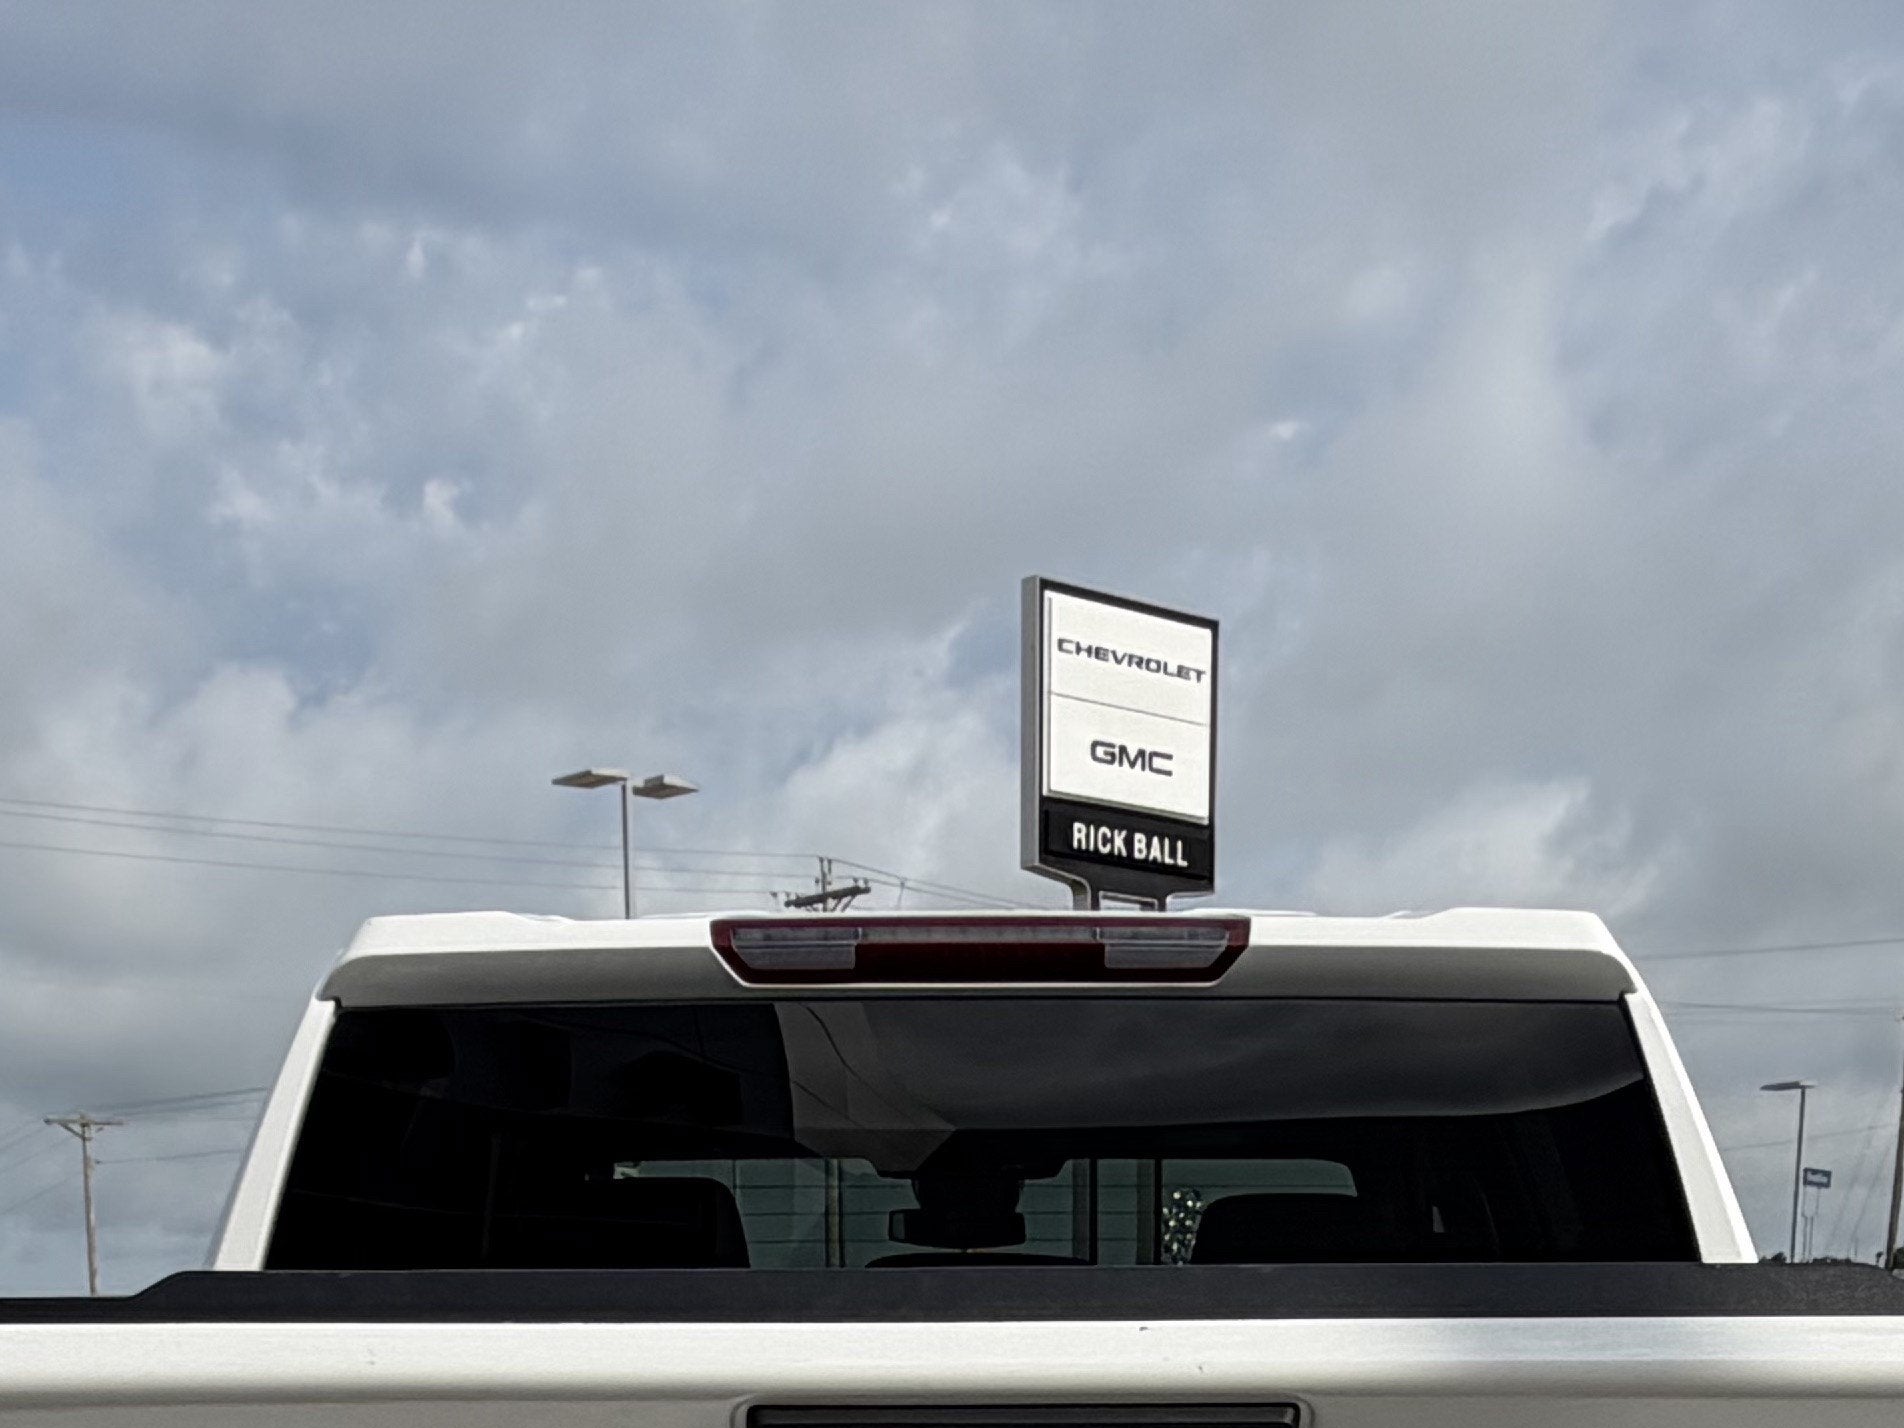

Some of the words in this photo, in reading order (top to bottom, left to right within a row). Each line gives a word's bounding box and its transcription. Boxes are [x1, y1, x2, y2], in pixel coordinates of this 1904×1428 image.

[1057, 637, 1206, 683] CHEVROLET
[1090, 740, 1173, 776] GMC
[1072, 822, 1127, 857] RICK
[1133, 832, 1188, 867] BALL
